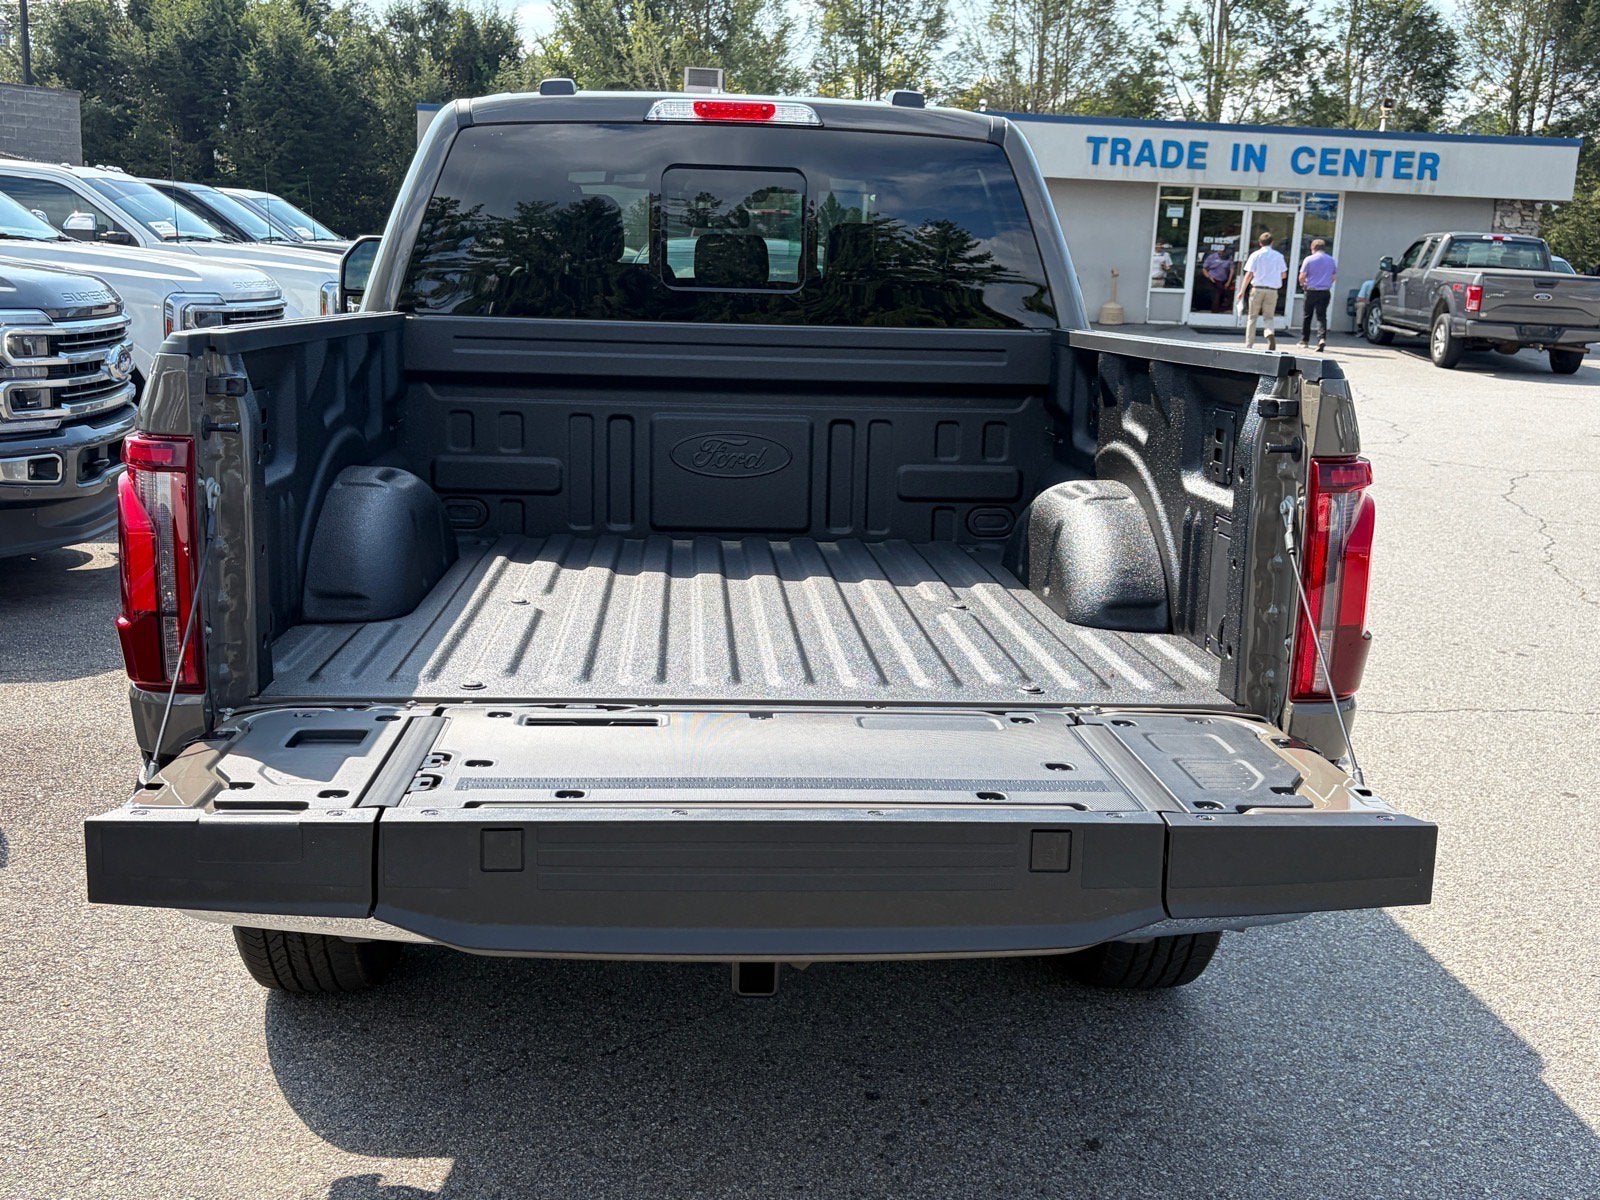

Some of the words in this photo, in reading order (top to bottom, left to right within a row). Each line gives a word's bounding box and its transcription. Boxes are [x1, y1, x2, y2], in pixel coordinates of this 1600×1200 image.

[1086, 136, 1209, 170] TRADE
[1230, 142, 1267, 173] IN
[1290, 145, 1440, 181] CENTER
[692, 437, 768, 470] Ford
